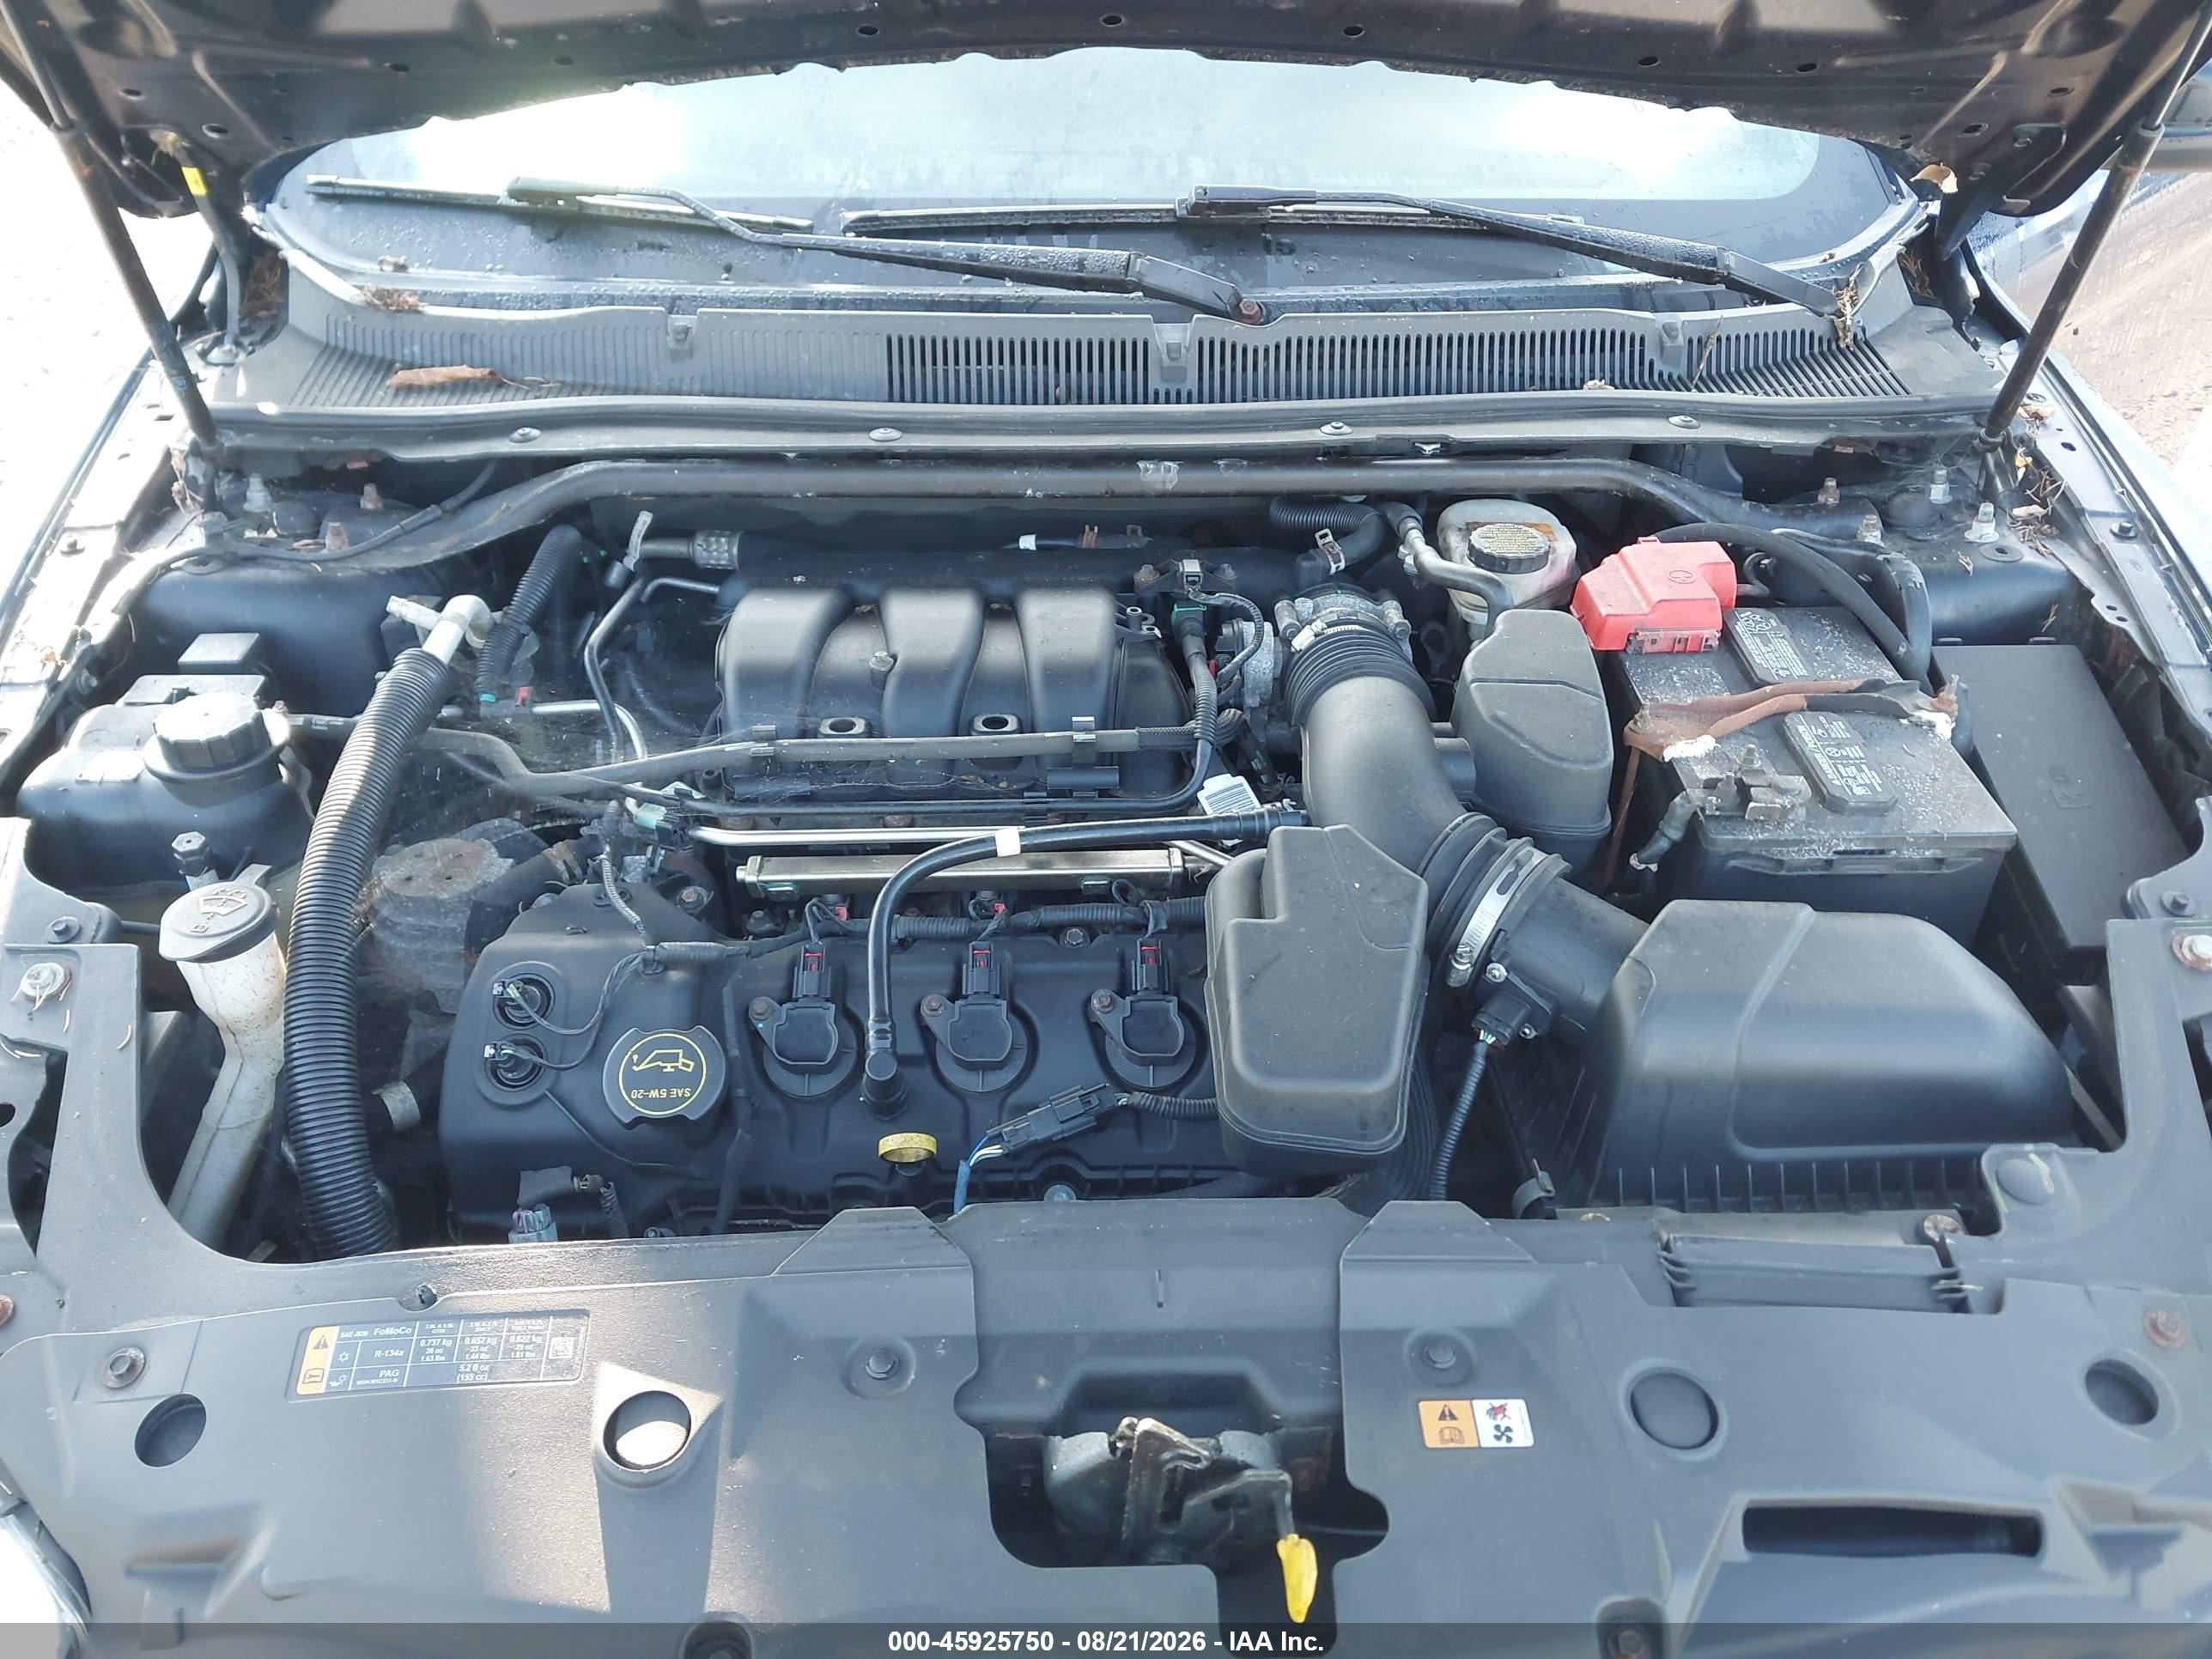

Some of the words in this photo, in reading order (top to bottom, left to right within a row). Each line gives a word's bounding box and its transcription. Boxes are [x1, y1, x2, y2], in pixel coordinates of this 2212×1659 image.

[1814, 752, 1837, 781] DANGER
[630, 1088, 668, 1099] 5W-20
[670, 1088, 691, 1097] SAE
[374, 1326, 412, 1336] FoMoCo
[459, 1364, 471, 1372] 5.2
[379, 1369, 399, 1377] PAG
